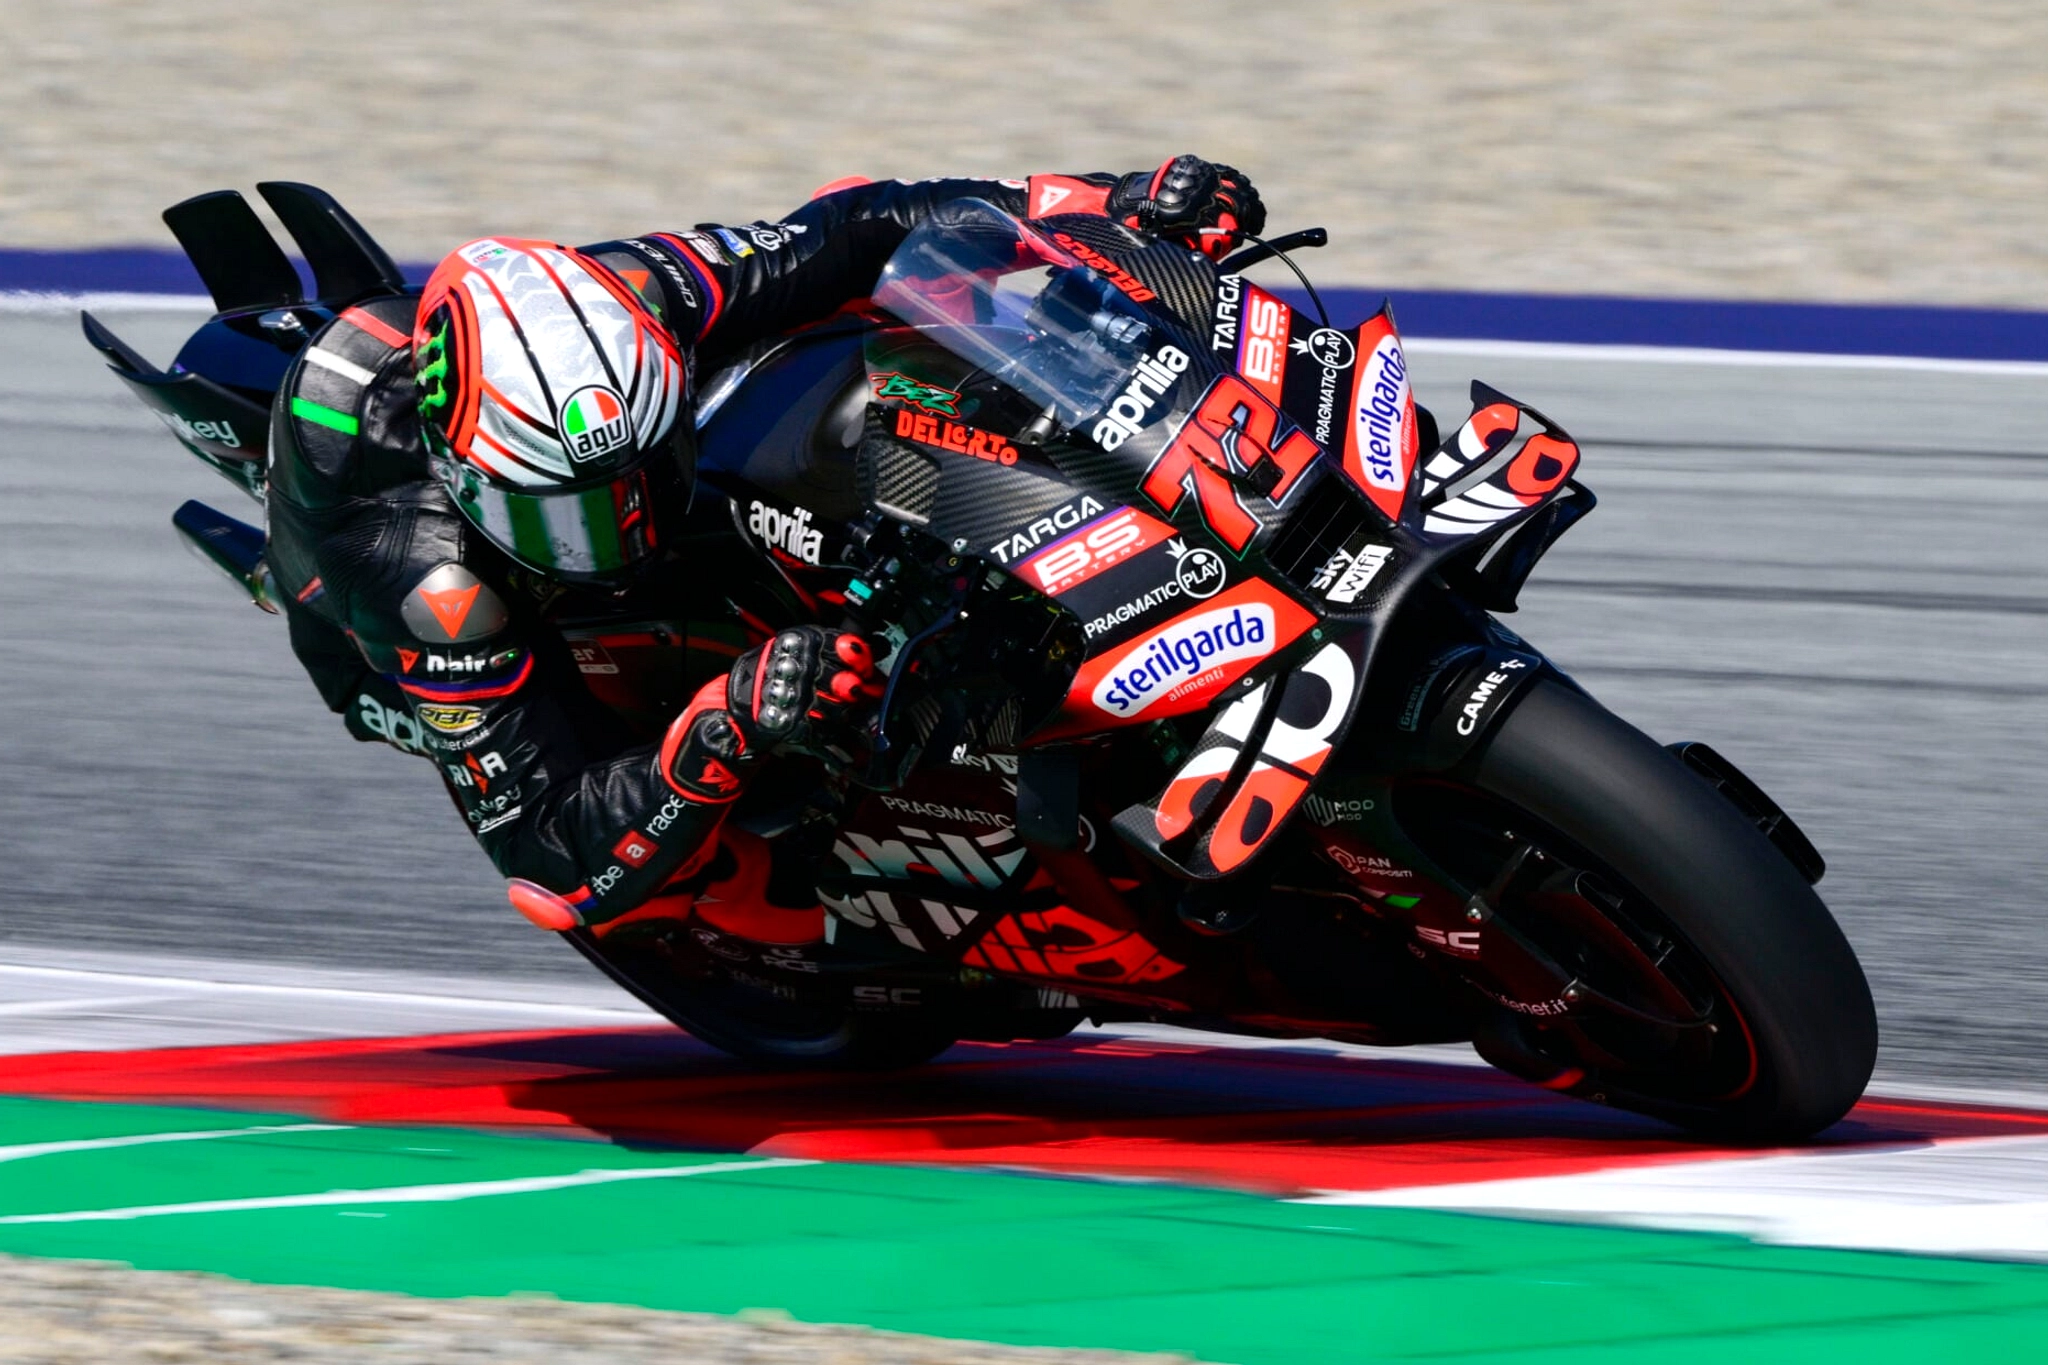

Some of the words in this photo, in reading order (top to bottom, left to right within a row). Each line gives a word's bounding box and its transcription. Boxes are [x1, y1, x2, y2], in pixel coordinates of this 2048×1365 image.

[1212, 274, 1241, 351] TARGA
[1244, 299, 1279, 385] BS
[1270, 302, 1288, 385] BATTERY
[1324, 331, 1344, 366] PLAY
[1092, 344, 1190, 453] aprilia
[1315, 366, 1338, 445] PRAGMATIC
[1355, 345, 1406, 484] sterilgarda
[577, 420, 622, 454] agv
[896, 409, 1018, 466] DELLORTO
[1138, 374, 1324, 560] 72
[750, 500, 823, 565] aprilia
[990, 495, 1104, 564] TARGA
[1034, 512, 1141, 588] BS
[1046, 540, 1147, 595] BATTERY
[1084, 581, 1182, 639] PRAGMATIC
[1182, 560, 1221, 589] PLAY
[1311, 547, 1355, 591] sky
[1338, 551, 1387, 597] wifi
[1106, 608, 1265, 711] sterilgarda
[1168, 667, 1225, 702] alimenti
[1456, 671, 1509, 737] CAME
[880, 795, 1016, 829] PRAGMATIC
[1333, 799, 1375, 812] MOD
